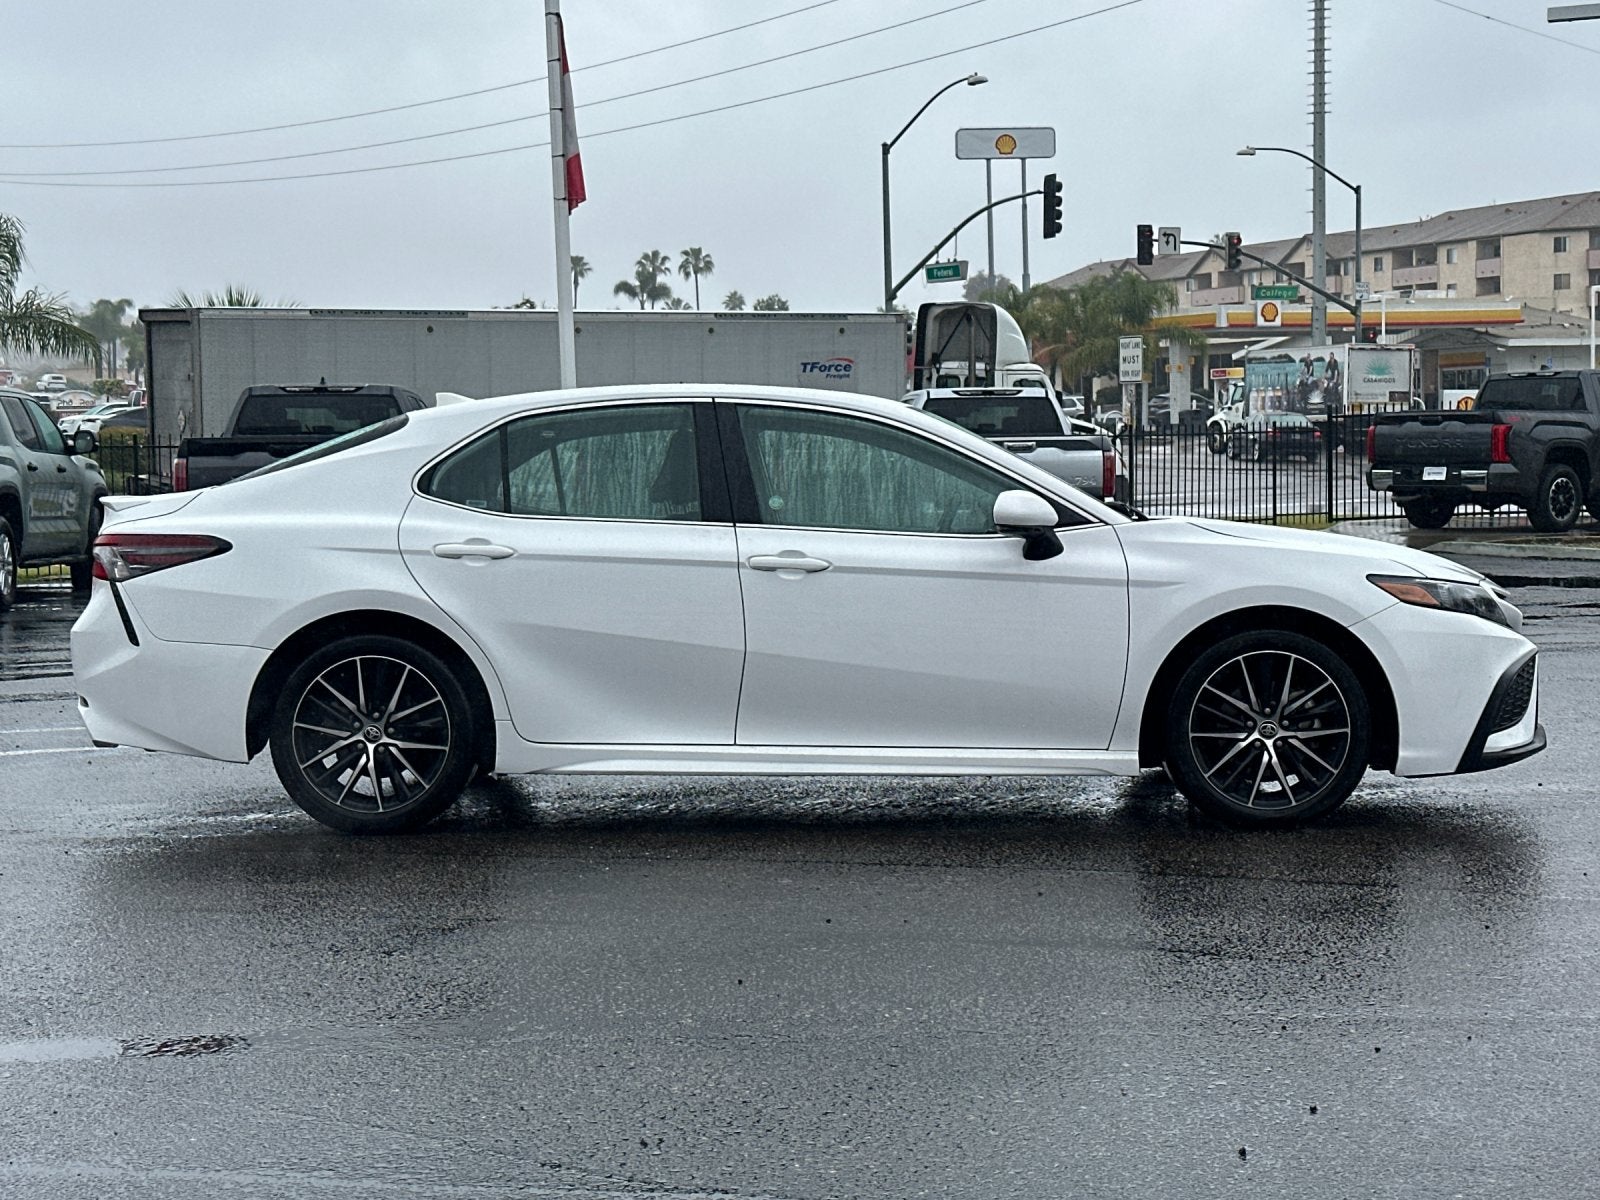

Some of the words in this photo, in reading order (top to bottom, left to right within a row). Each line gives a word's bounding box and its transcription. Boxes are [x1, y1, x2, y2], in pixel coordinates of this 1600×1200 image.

[1260, 289, 1292, 297] College
[1122, 355, 1139, 364] MUST
[800, 362, 852, 373] TForce
[1395, 438, 1464, 448] TUNDRA
